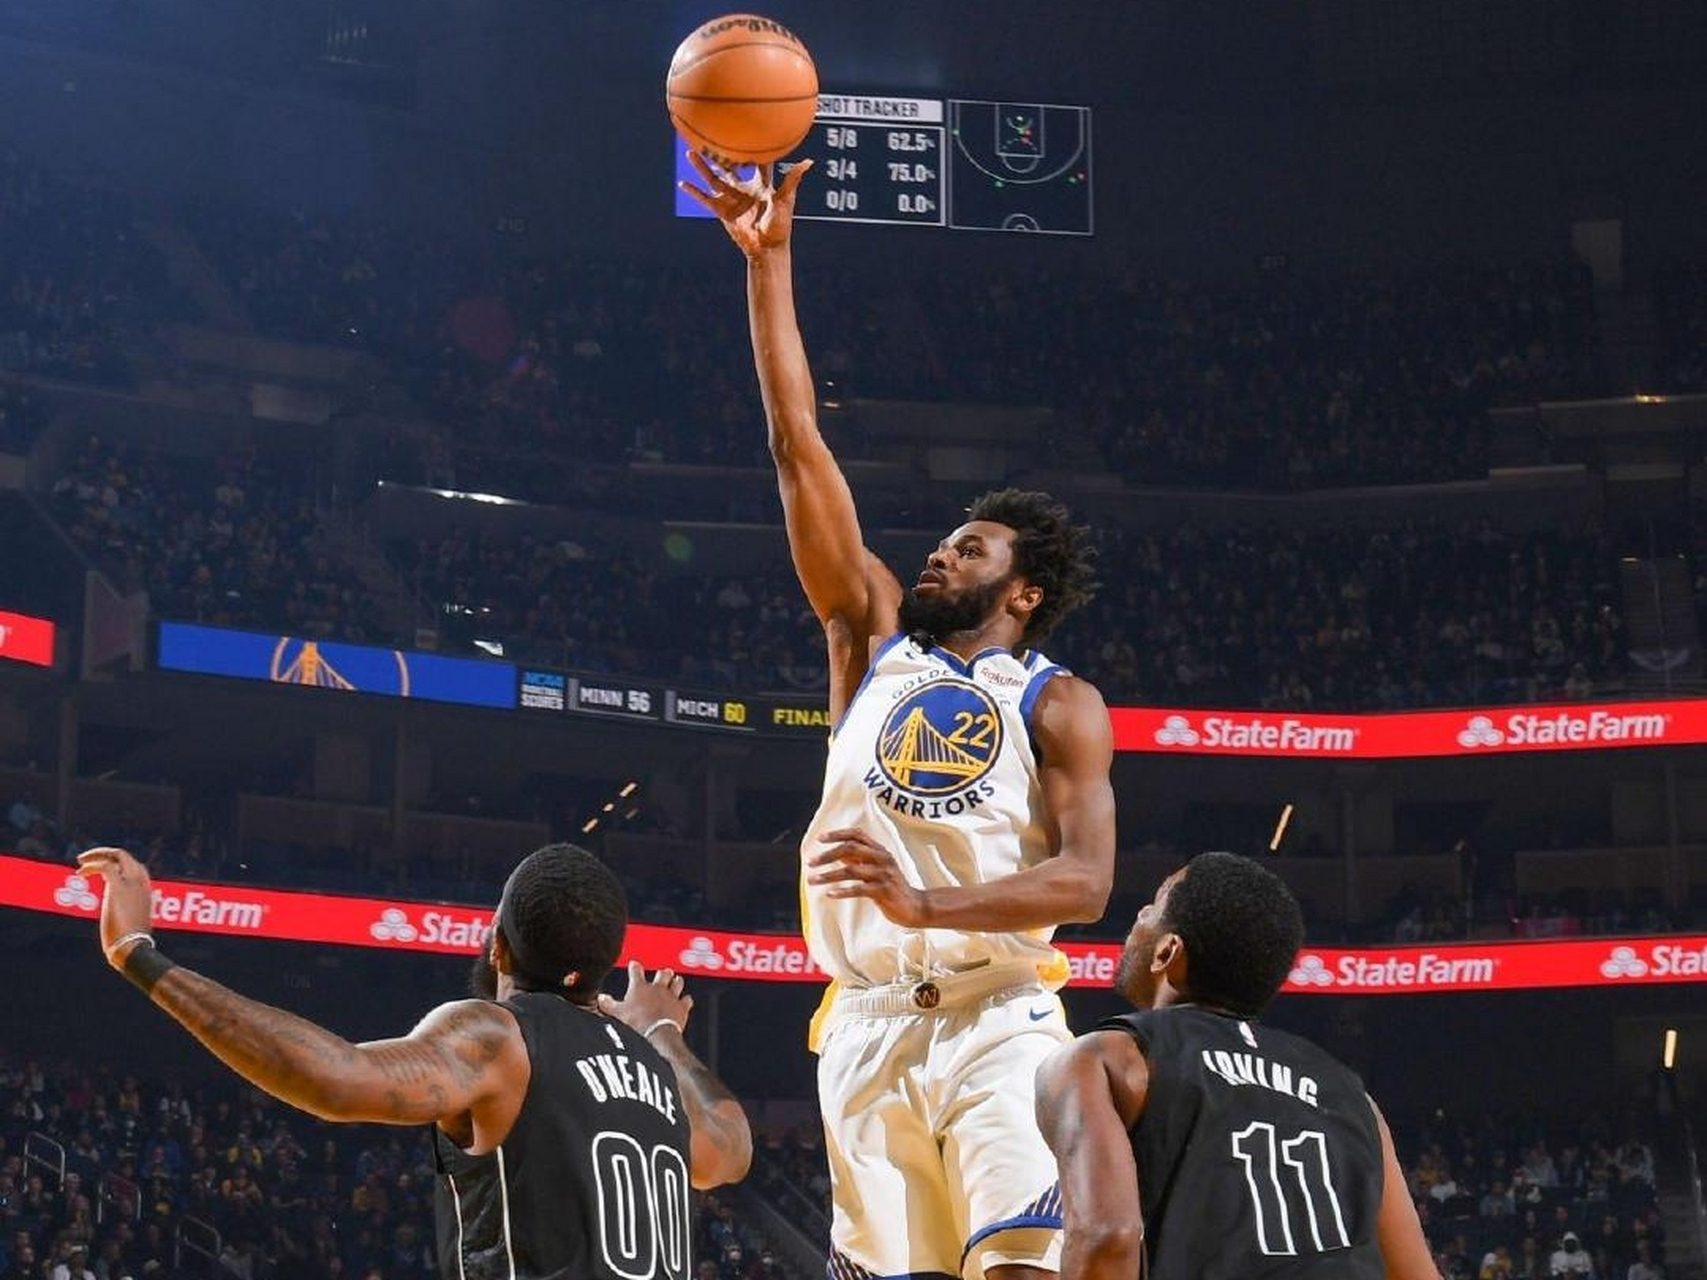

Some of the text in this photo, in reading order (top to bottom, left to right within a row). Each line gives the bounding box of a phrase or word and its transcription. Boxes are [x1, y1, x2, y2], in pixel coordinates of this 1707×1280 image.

[854, 99, 919, 117] TRACKER
[826, 128, 857, 149] 5/8
[826, 158, 858, 181] 3/4
[826, 190, 858, 211] 0/0
[580, 687, 624, 706] MINN
[628, 690, 651, 713] 56
[677, 699, 746, 724] MICH 60
[948, 711, 996, 749] 22
[863, 766, 996, 819] WARRIORS
[575, 1053, 678, 1126] O'NEALE
[1201, 1050, 1319, 1108] IRVING
[1231, 1120, 1352, 1256] 11
[591, 1130, 692, 1280] 00
